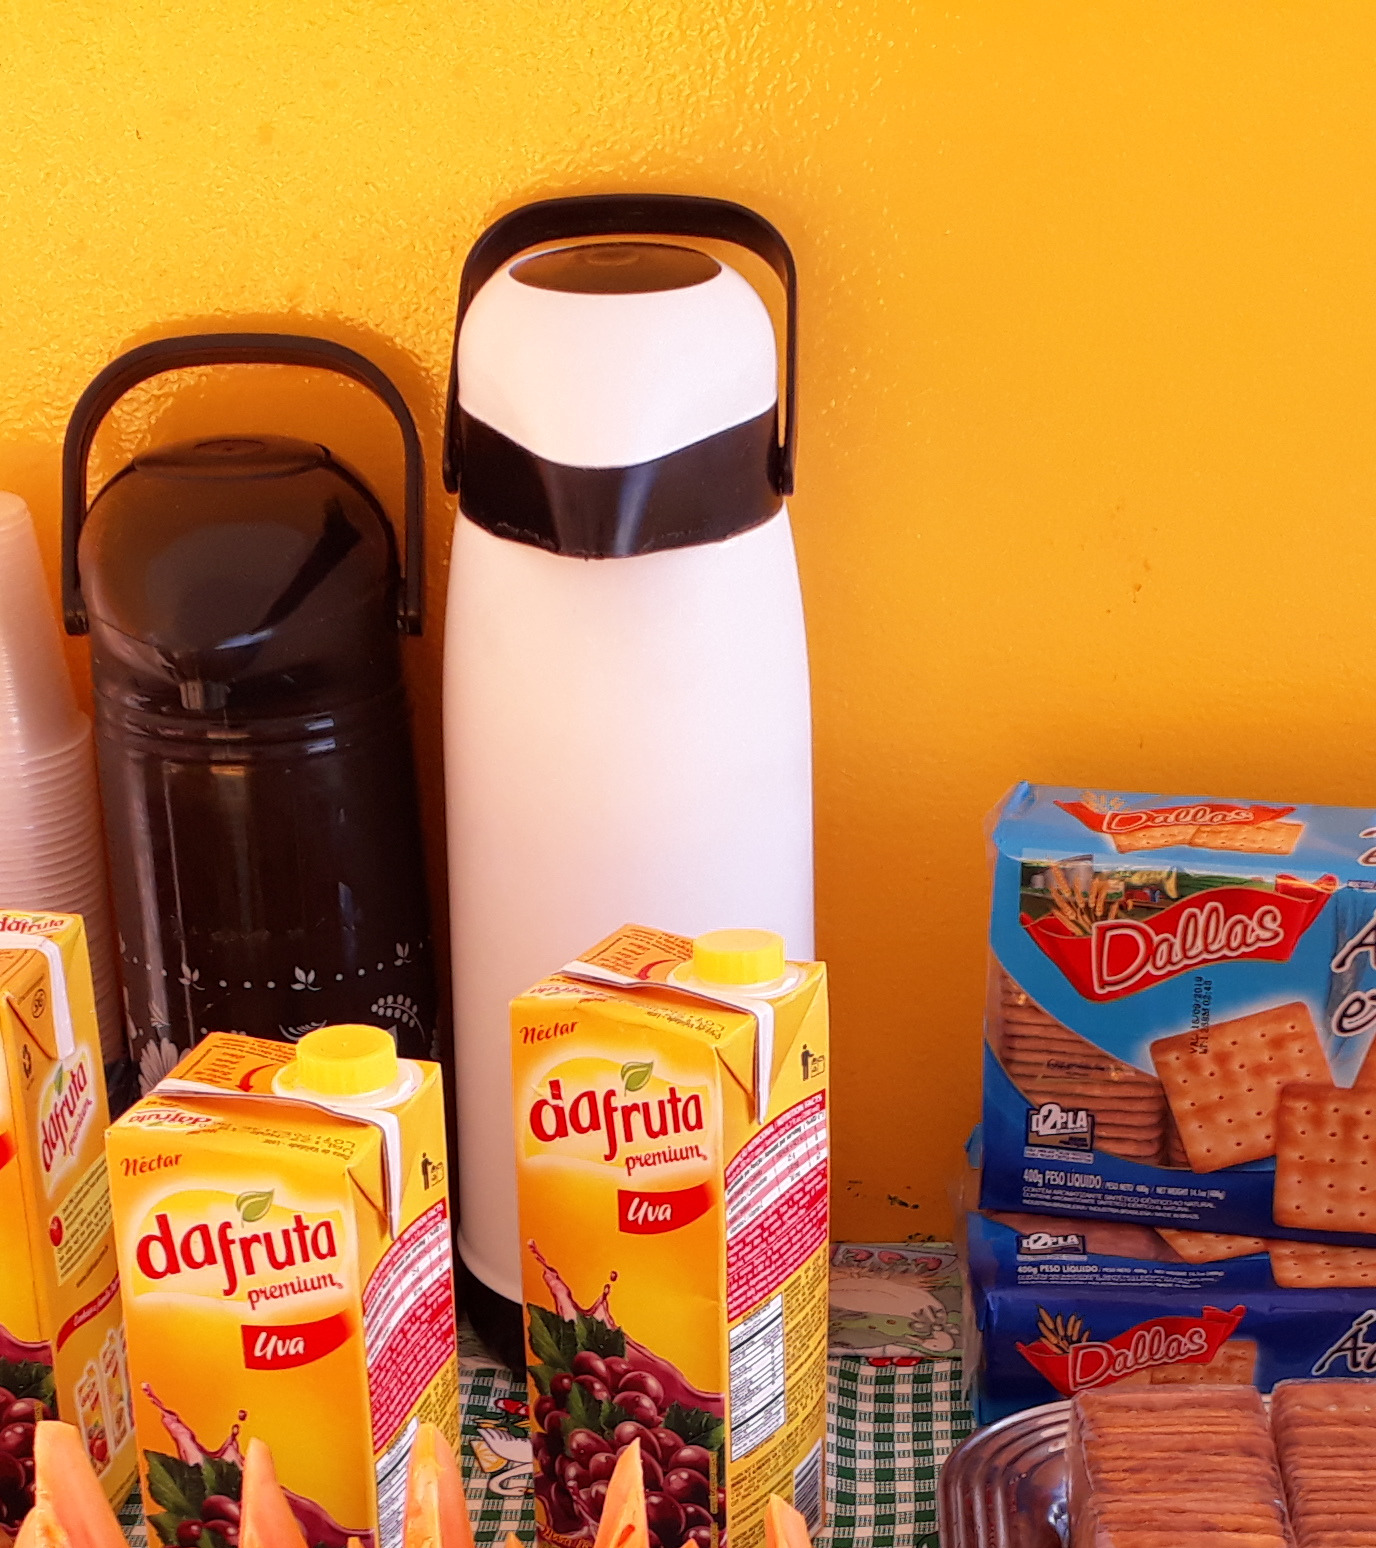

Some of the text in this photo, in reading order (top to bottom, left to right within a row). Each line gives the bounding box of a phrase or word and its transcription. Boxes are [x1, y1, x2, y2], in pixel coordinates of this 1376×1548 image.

[1102, 806, 1255, 832] Dallas
[1092, 903, 1284, 994] Dallas
[519, 1021, 579, 1044] Néctar
[42, 1061, 87, 1172] dafruta
[529, 1079, 703, 1161] dafruta
[120, 1153, 183, 1176] Néctar
[626, 1144, 707, 1176] premium
[627, 1197, 672, 1224] Uva
[136, 1213, 337, 1296] dafruta
[247, 1272, 343, 1310] premium
[254, 1332, 305, 1360] Uva
[1069, 1327, 1208, 1390] Dallas
